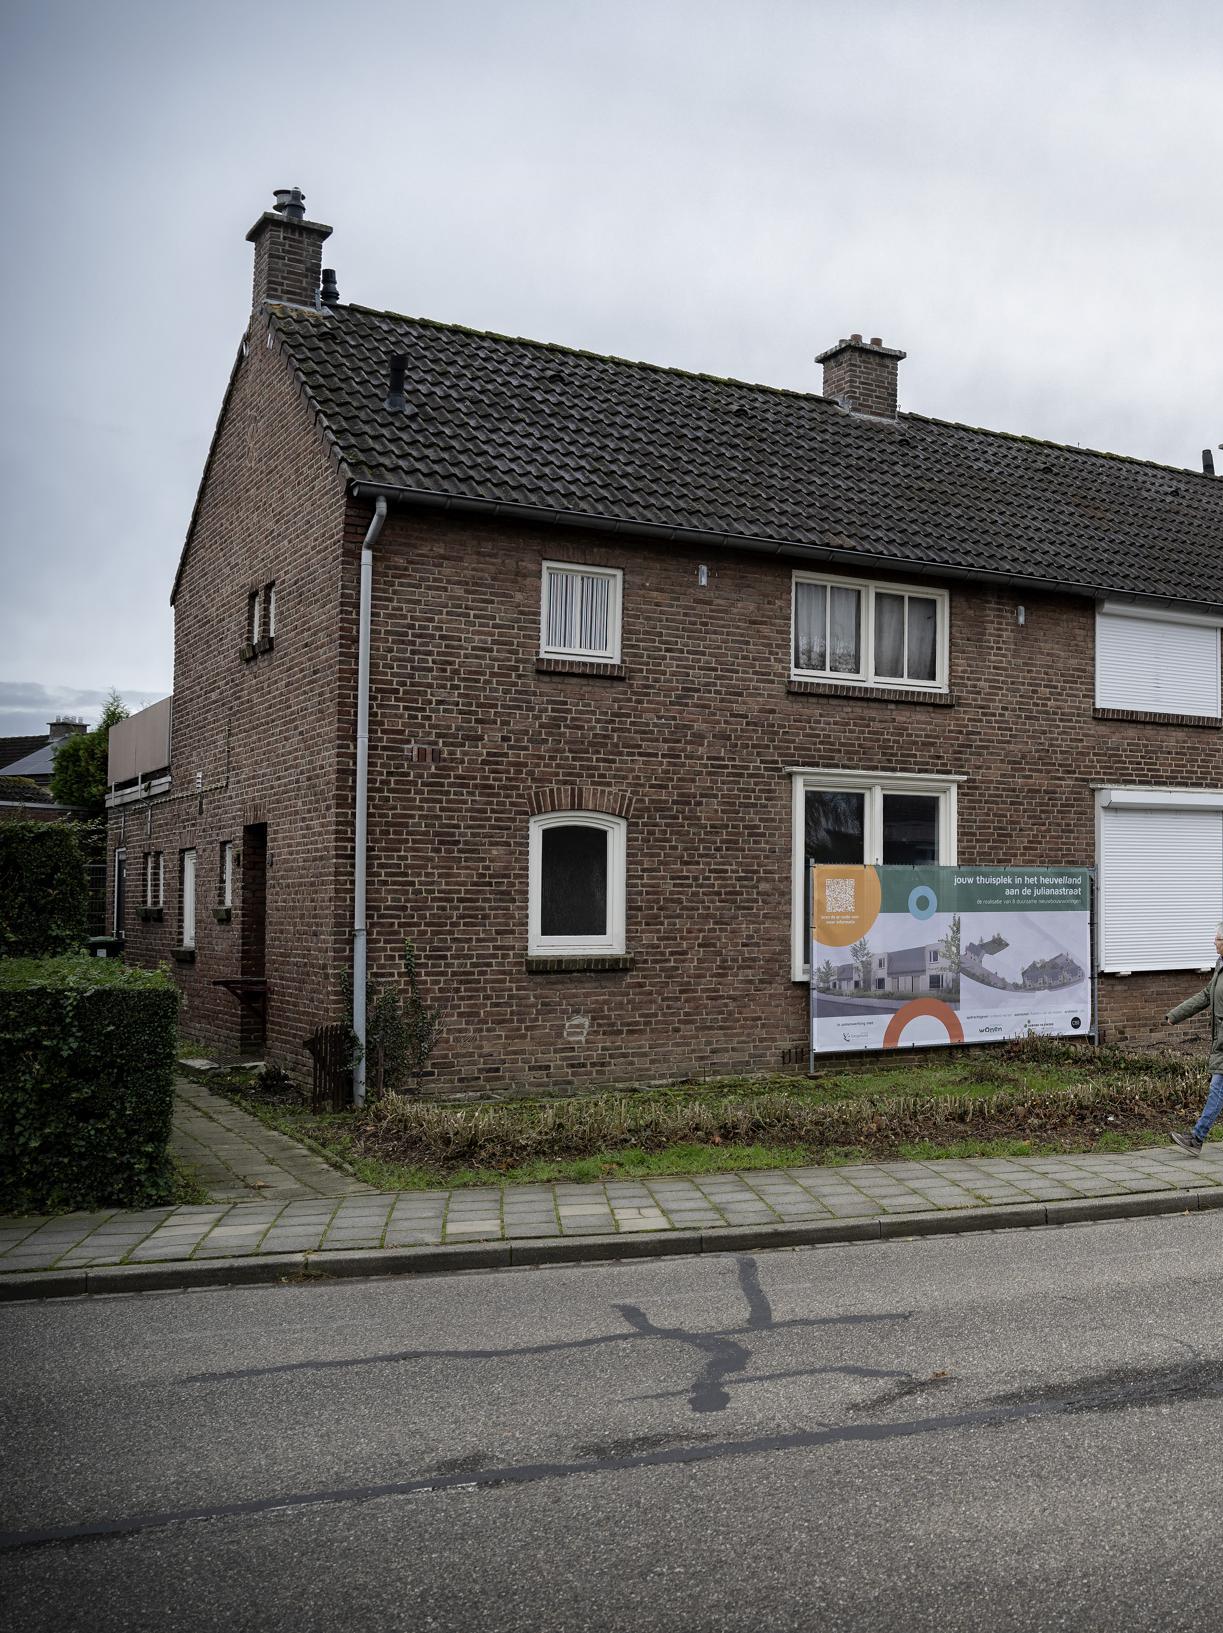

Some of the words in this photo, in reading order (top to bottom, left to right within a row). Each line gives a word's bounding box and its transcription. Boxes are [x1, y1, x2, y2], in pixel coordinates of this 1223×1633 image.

[954, 875, 974, 886] jouw
[976, 875, 1012, 886] thuisplek
[1015, 875, 1022, 884] in
[1025, 875, 1038, 885] het
[1040, 875, 1082, 885] heuvelland
[1005, 888, 1020, 896] aan
[1021, 887, 1032, 896] de
[1033, 887, 1081, 897] julianastraat
